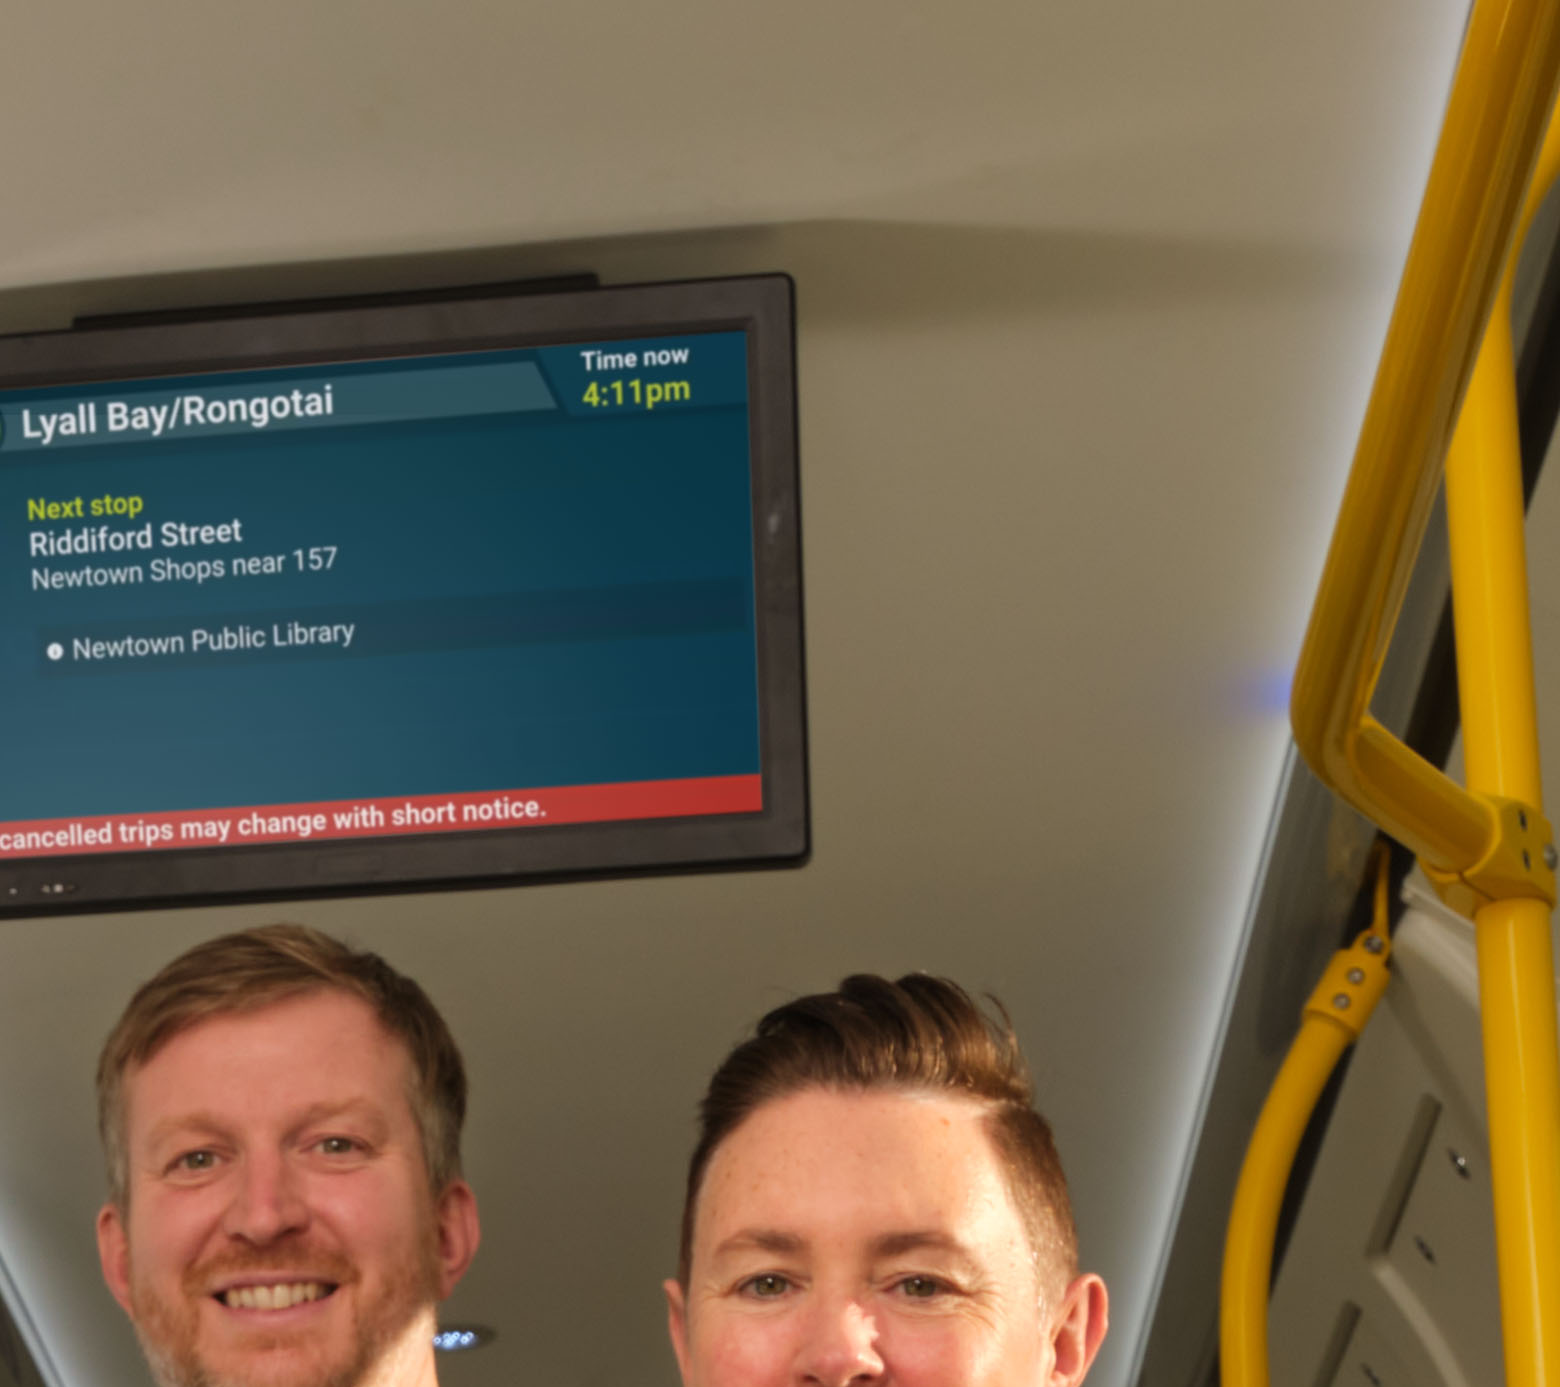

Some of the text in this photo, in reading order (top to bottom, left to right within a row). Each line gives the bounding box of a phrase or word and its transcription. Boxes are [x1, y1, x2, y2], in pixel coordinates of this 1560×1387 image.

[580, 348, 689, 371] Time now
[582, 378, 690, 409] 4:11pm
[23, 403, 96, 445] Lyall
[108, 383, 333, 437] Bay/Rongotai
[28, 494, 143, 520] Next stop
[30, 519, 243, 557] Riddiford Street
[32, 546, 337, 590] Newtown Shops near 157
[73, 622, 355, 660] Newtown Public Library
[0, 797, 547, 850] cancelled trips may change with short notice.
